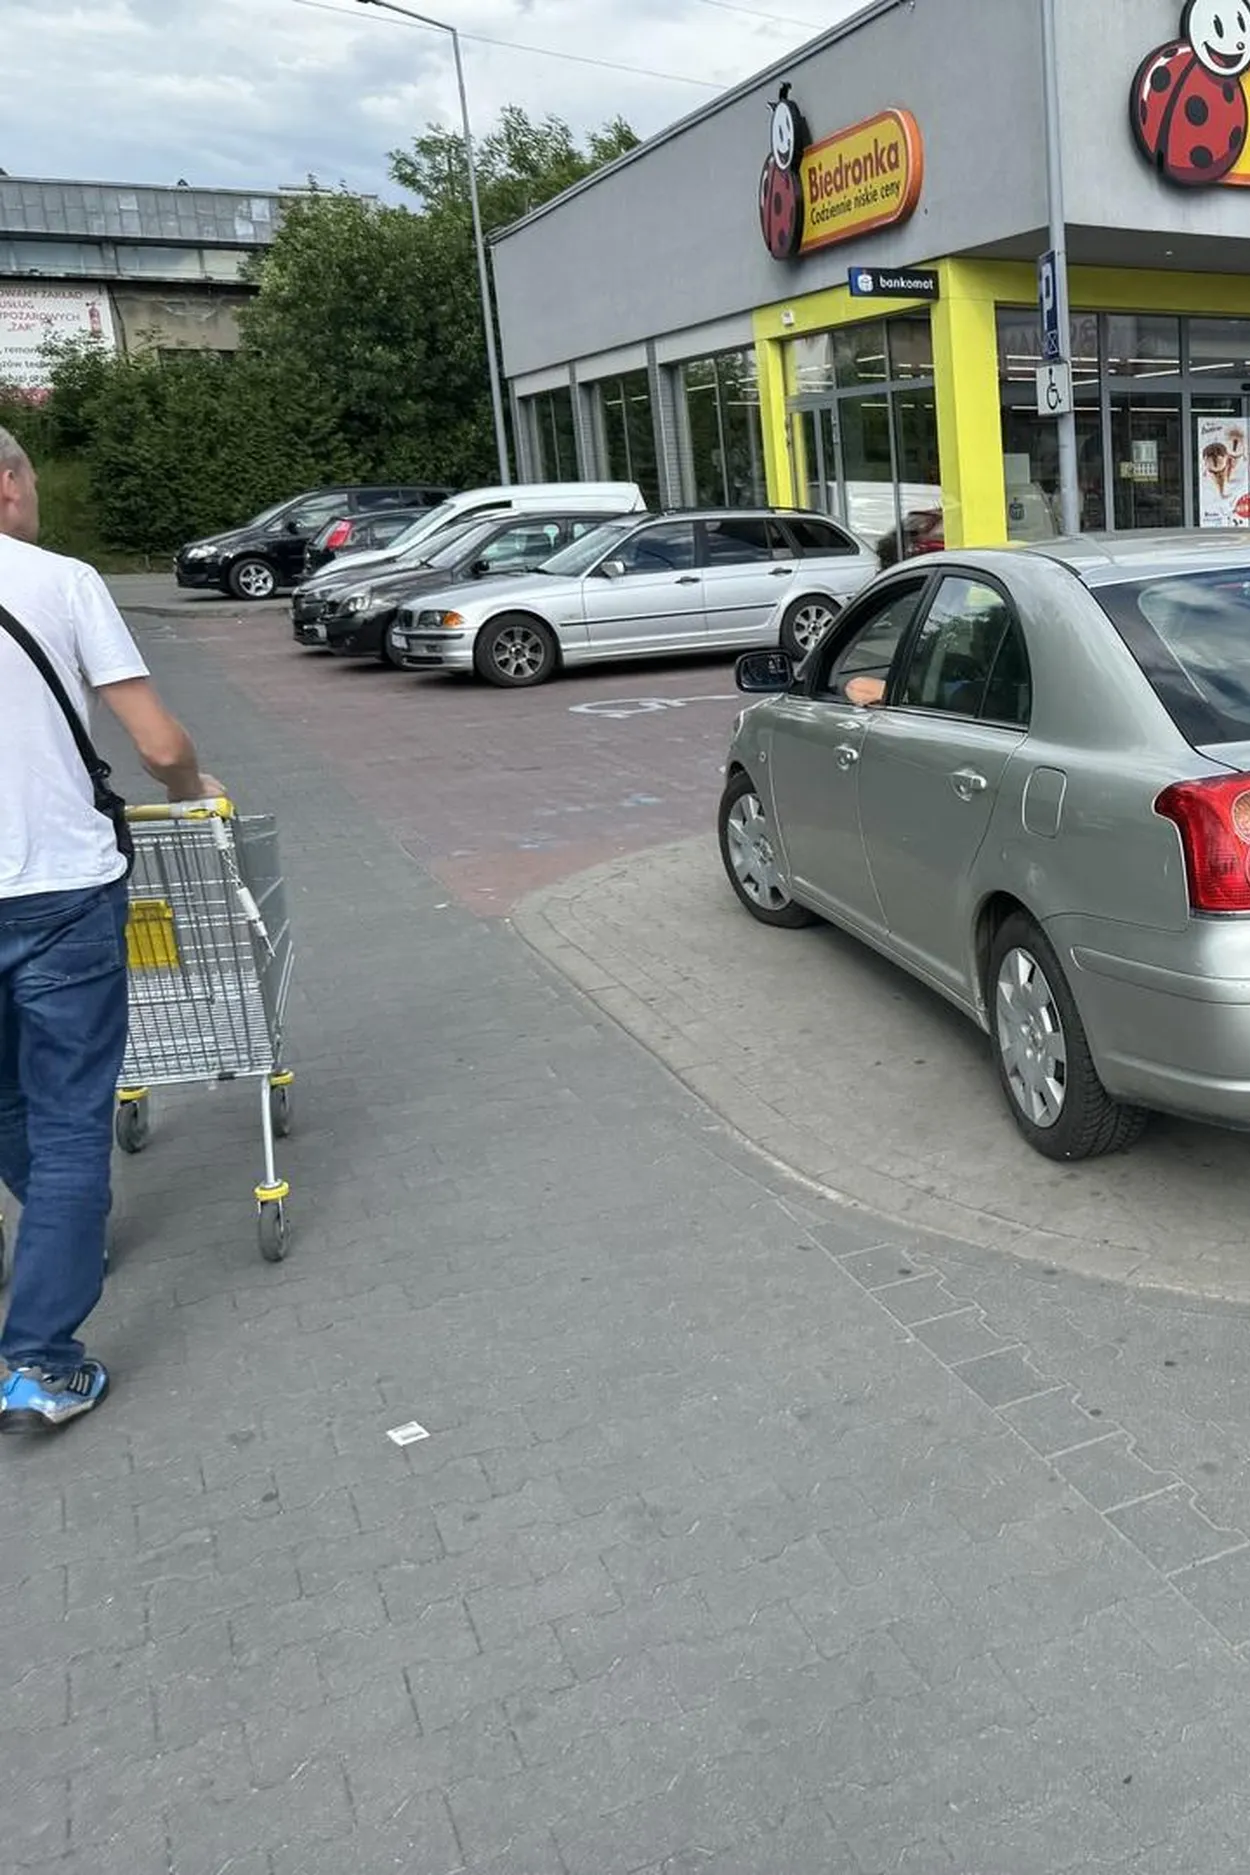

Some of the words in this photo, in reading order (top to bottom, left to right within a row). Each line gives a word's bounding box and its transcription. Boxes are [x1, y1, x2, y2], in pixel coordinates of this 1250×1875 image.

[807, 138, 900, 205] Biedronka
[810, 195, 853, 226] Codziennie
[854, 183, 879, 209] niskie
[880, 180, 901, 201] ceny
[879, 275, 934, 290] bankomat
